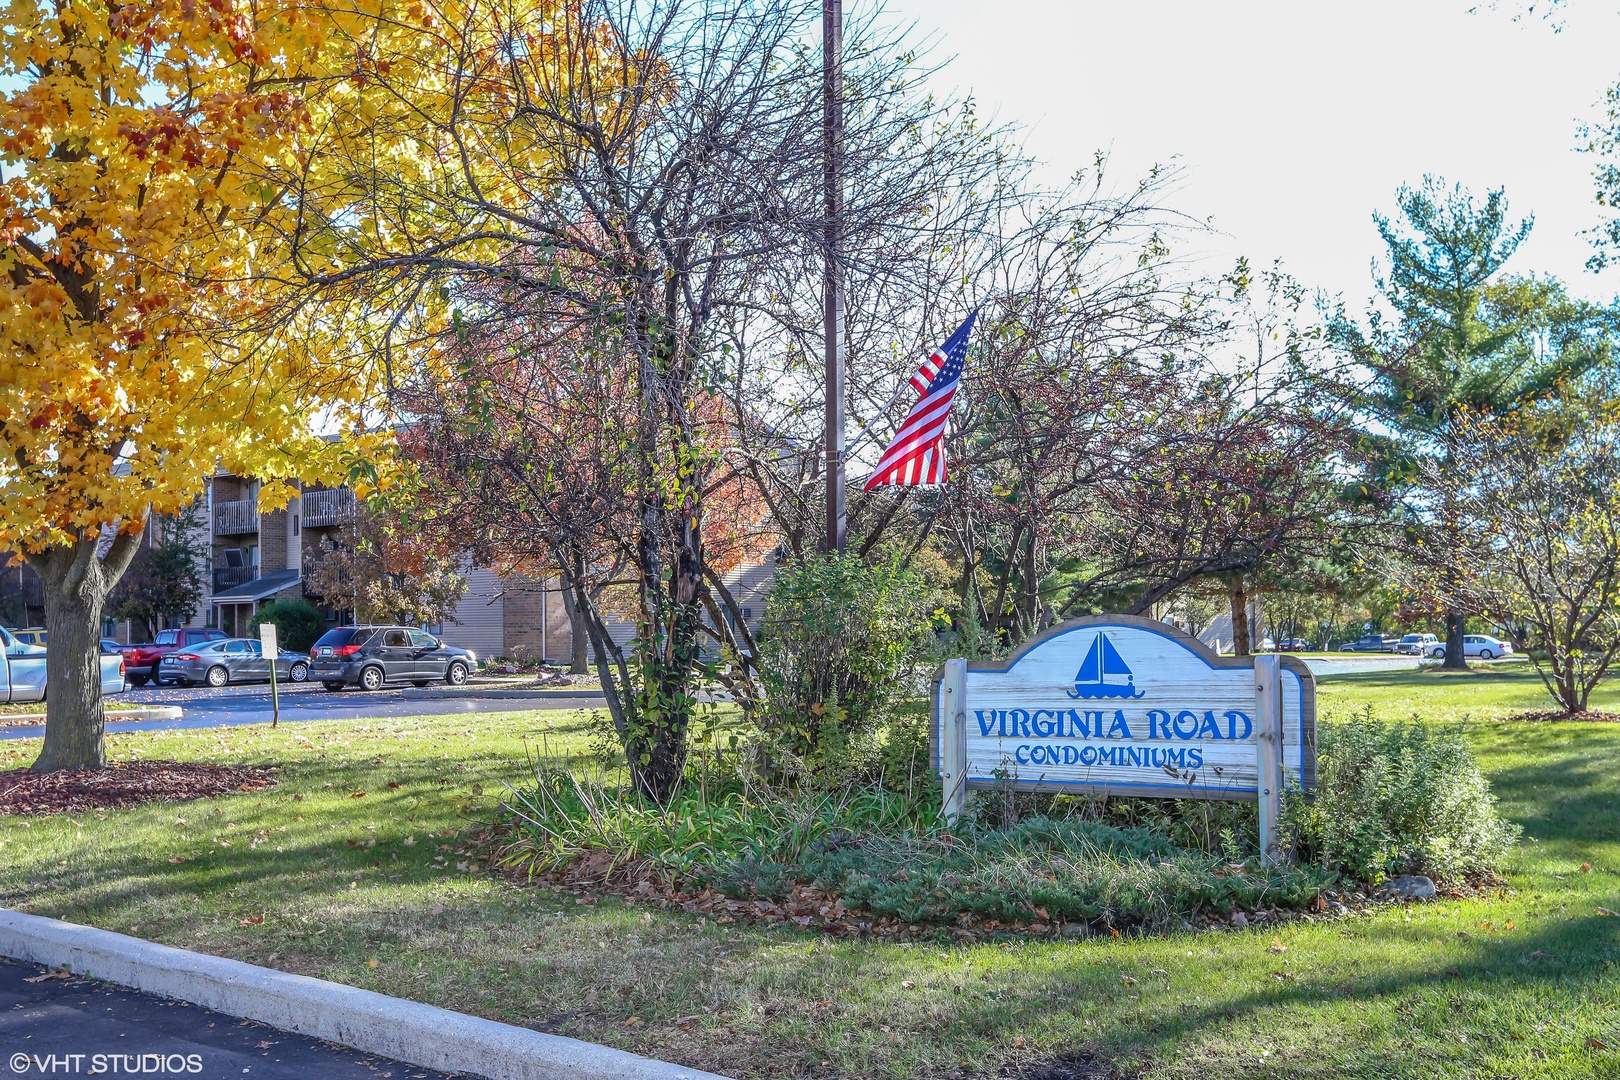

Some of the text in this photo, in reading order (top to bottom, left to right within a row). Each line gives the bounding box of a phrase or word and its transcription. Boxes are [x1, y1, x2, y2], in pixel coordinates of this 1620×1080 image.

[975, 708, 1253, 740] VIRGINIA ROAD
[1016, 745, 1204, 769] CONDOMINIUMS
